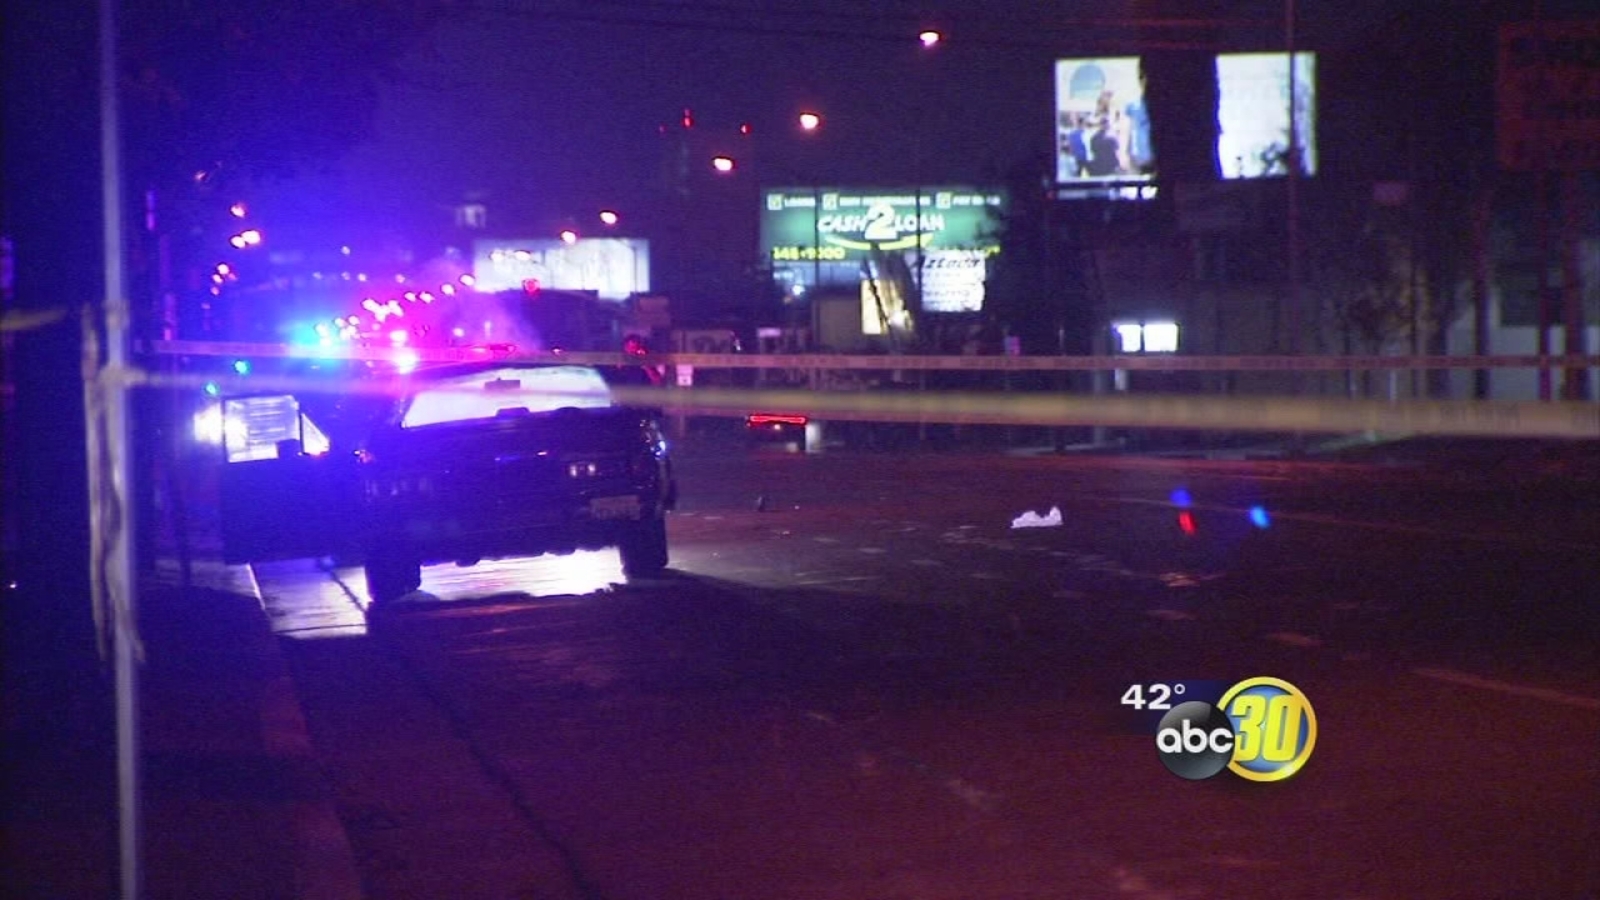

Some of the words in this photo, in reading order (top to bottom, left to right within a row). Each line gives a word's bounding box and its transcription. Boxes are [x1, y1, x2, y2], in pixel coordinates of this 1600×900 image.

[817, 214, 868, 232] CASH
[865, 200, 897, 239] 2
[894, 213, 945, 232] LOAN
